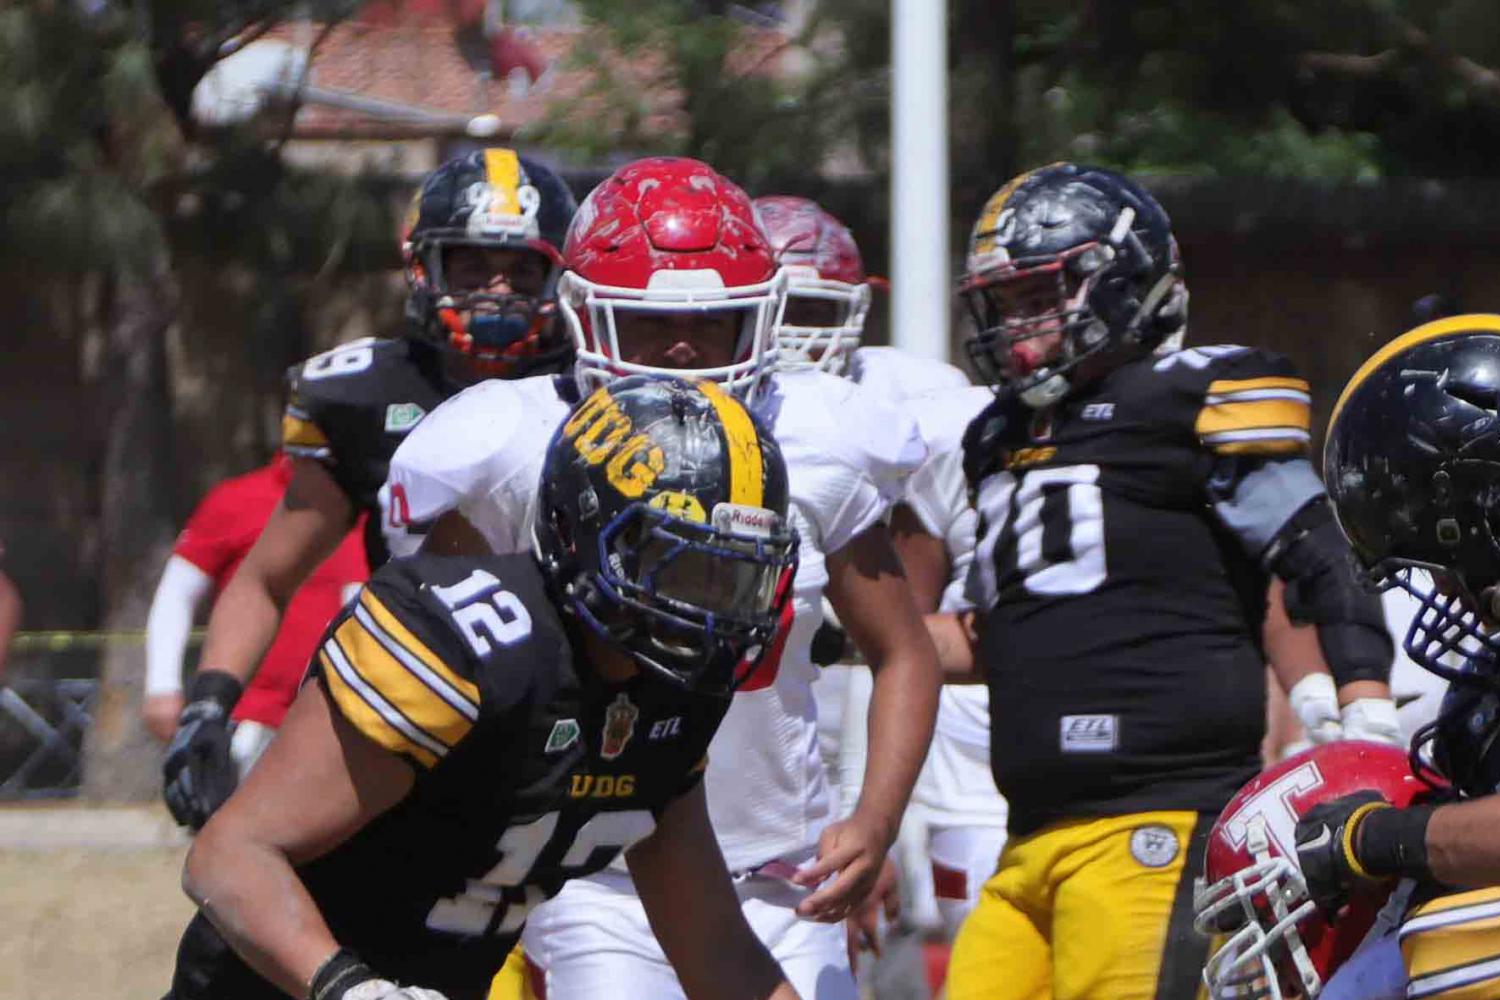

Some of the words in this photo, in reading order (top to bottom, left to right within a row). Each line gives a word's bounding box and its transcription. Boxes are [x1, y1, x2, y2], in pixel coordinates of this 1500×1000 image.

[562, 388, 666, 497] UDG
[975, 464, 1107, 608] 70
[430, 569, 532, 657] 12
[650, 716, 682, 740] ETL
[569, 773, 636, 798] UDG
